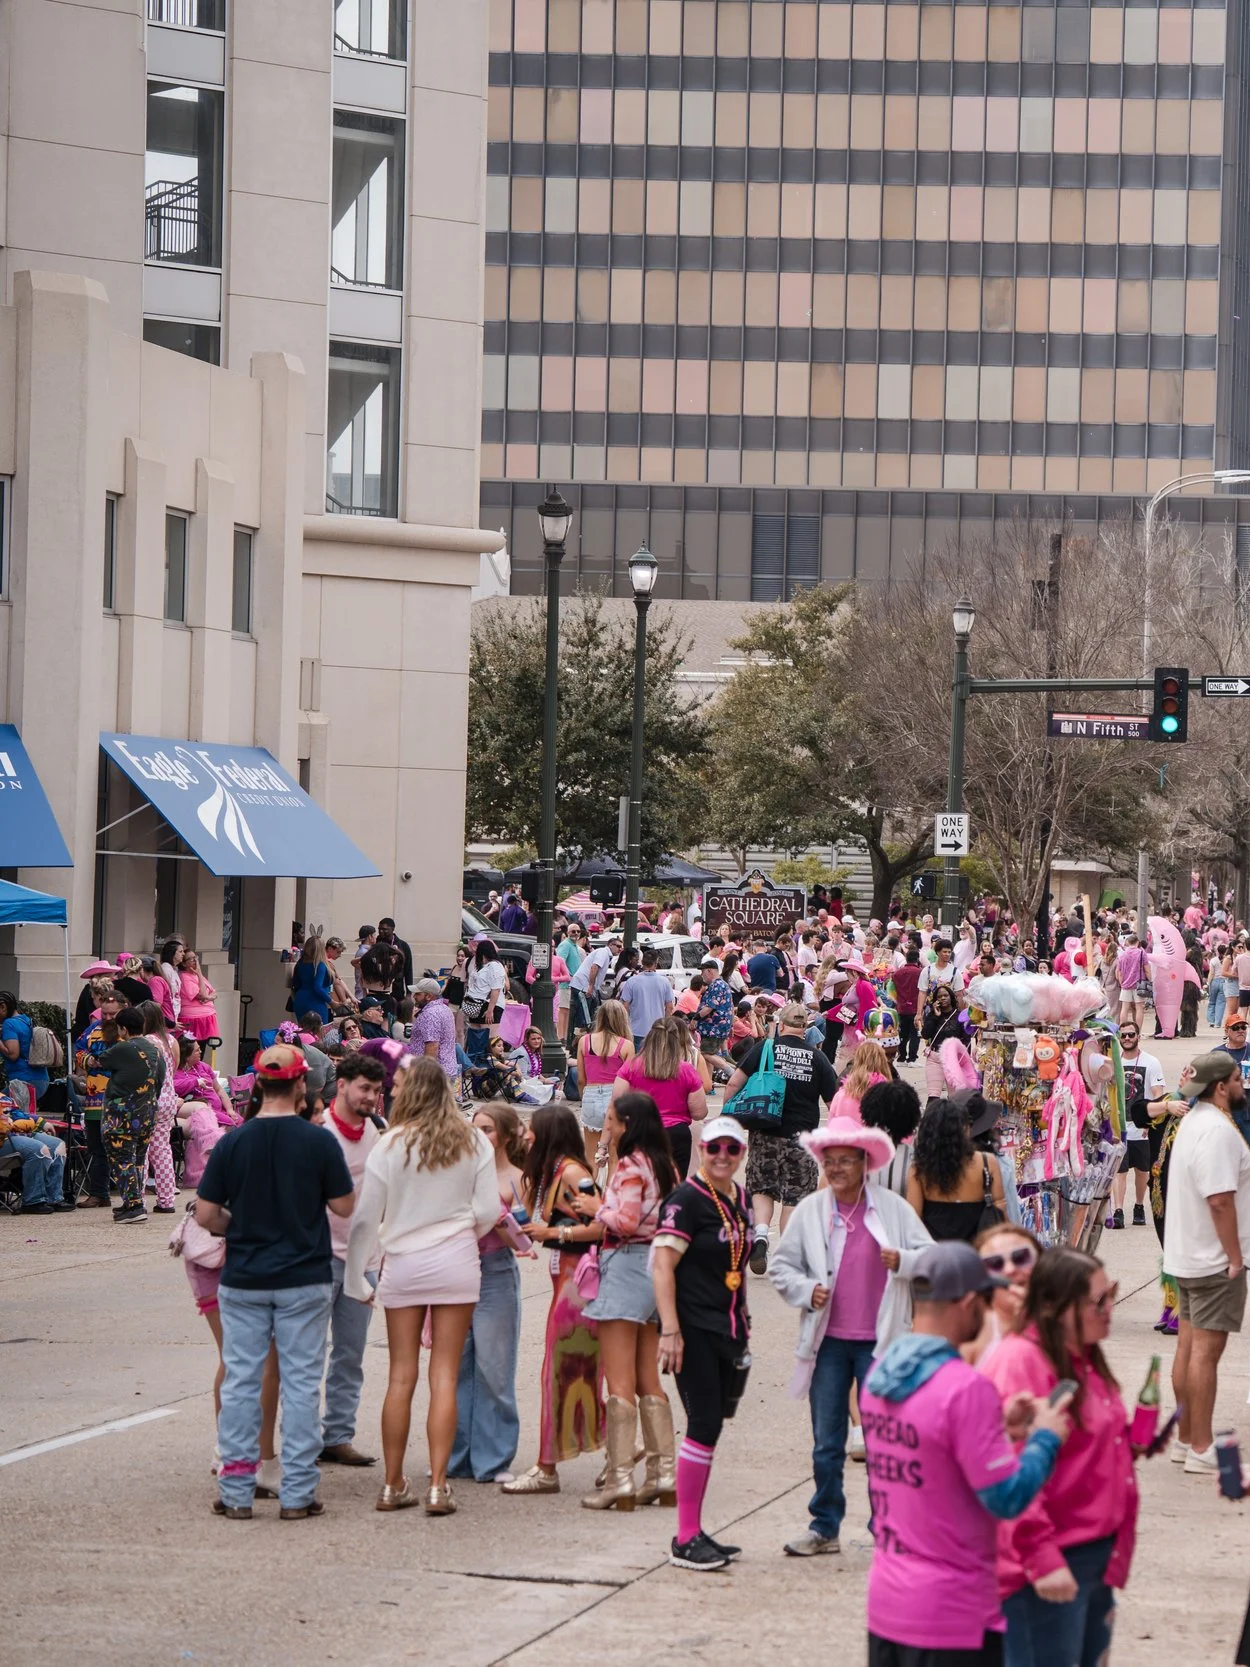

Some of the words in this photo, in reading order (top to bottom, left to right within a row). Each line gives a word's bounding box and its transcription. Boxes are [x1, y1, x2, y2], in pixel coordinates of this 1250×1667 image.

[1077, 721, 1086, 734] N
[1093, 722, 1124, 736] Fifth
[1129, 723, 1139, 731] ST
[112, 740, 200, 791] Eagle
[196, 750, 292, 792] Federal
[236, 792, 275, 806] CREDIT
[272, 795, 306, 808] UNION
[941, 817, 963, 826] ONE
[941, 828, 964, 838] WAY
[708, 896, 801, 912] CATHEDRAL
[725, 911, 786, 927] SQUARE
[797, 1057, 812, 1066] DELI
[863, 1412, 920, 1450] PREAD
[867, 1453, 924, 1489] HEEKS
